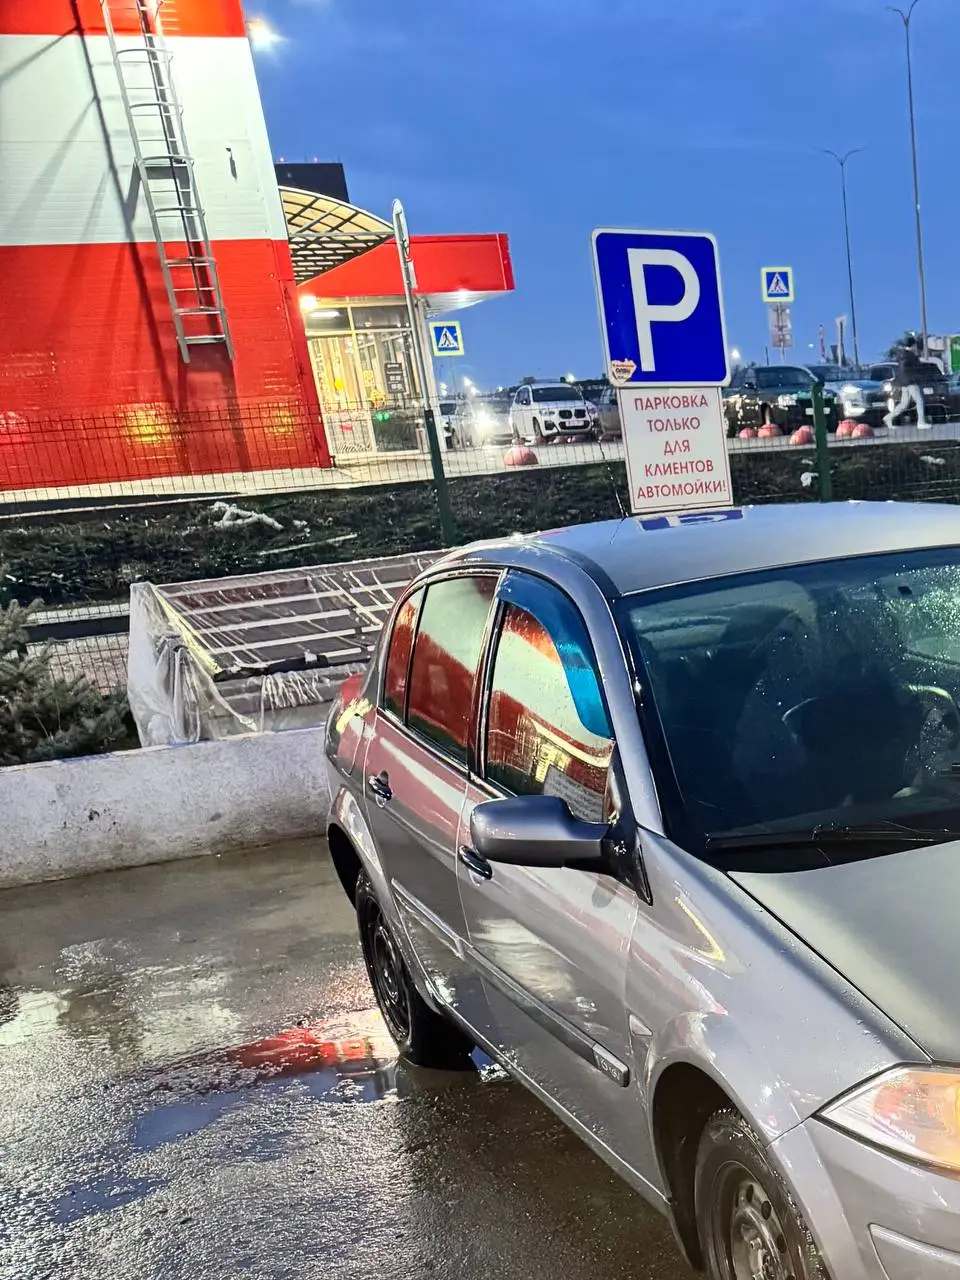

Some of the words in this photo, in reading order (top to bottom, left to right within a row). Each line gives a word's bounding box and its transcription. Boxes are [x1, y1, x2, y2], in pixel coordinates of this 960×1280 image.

[627, 248, 700, 372] P
[634, 395, 709, 411] ПАРКОВКА
[647, 416, 701, 432] ТОЛЬКО
[663, 439, 691, 456] ДЛЯ
[644, 459, 714, 477] КЛИЕНТОВ
[637, 479, 727, 499] АВТОМОЙКИ!
